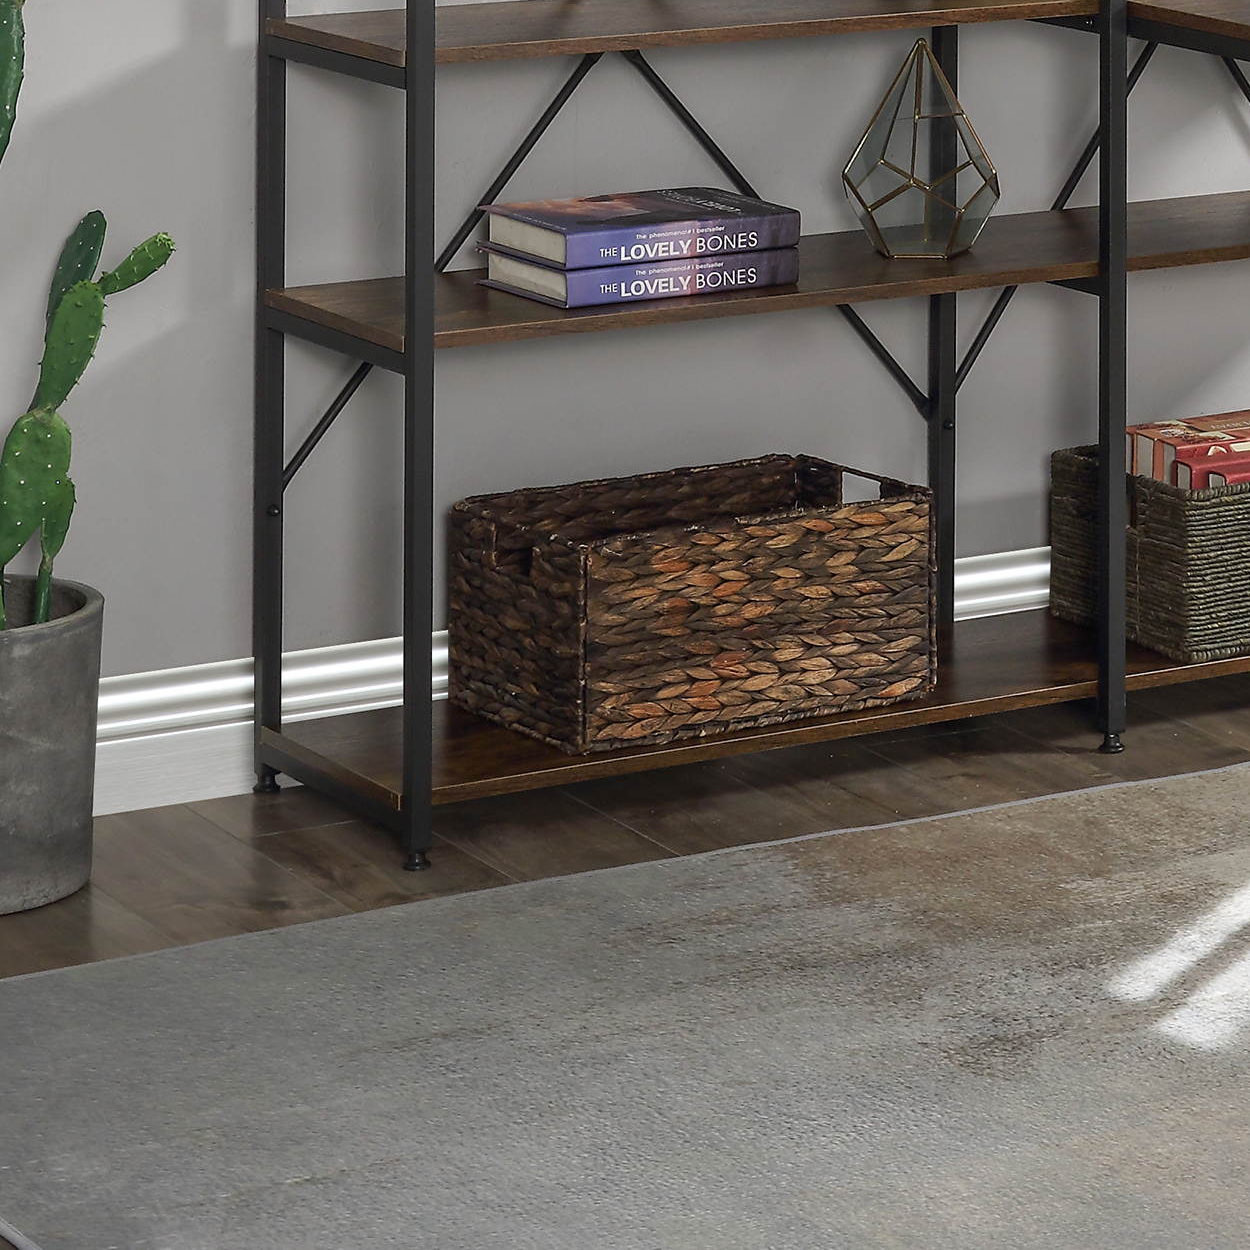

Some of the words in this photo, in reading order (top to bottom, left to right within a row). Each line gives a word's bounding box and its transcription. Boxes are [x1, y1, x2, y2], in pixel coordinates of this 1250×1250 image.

[696, 225, 725, 234] bestseller
[600, 247, 618, 258] THE
[620, 239, 692, 261] LOVELY
[696, 231, 758, 253] BONES
[695, 261, 725, 270] bestseller
[600, 282, 618, 294] THE
[620, 275, 692, 297] LOVELY
[696, 267, 757, 289] BONES
